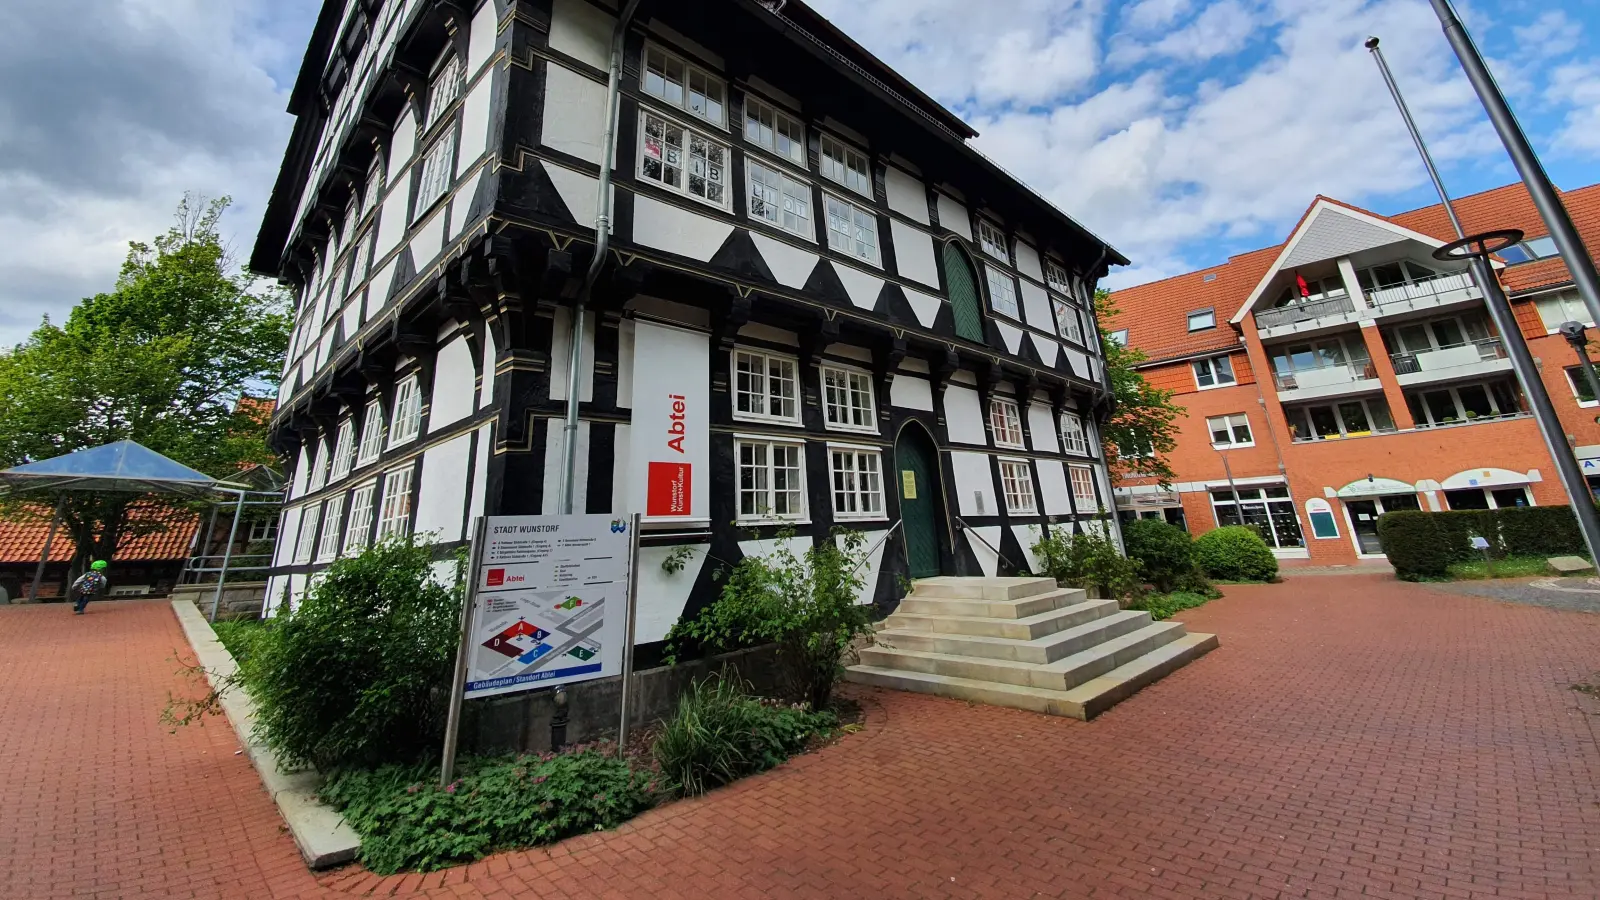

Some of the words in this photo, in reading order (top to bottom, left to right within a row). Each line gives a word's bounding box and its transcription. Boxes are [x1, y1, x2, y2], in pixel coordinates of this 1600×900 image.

[668, 394, 685, 454] Abtei
[494, 525, 518, 534] STADT
[519, 524, 560, 534] WUNSTORF
[517, 622, 524, 632] A
[536, 631, 542, 639] B
[494, 638, 500, 647] D
[533, 649, 538, 658] C
[579, 649, 584, 658] E
[516, 674, 540, 683] Standort
[541, 671, 556, 679] Abtei
